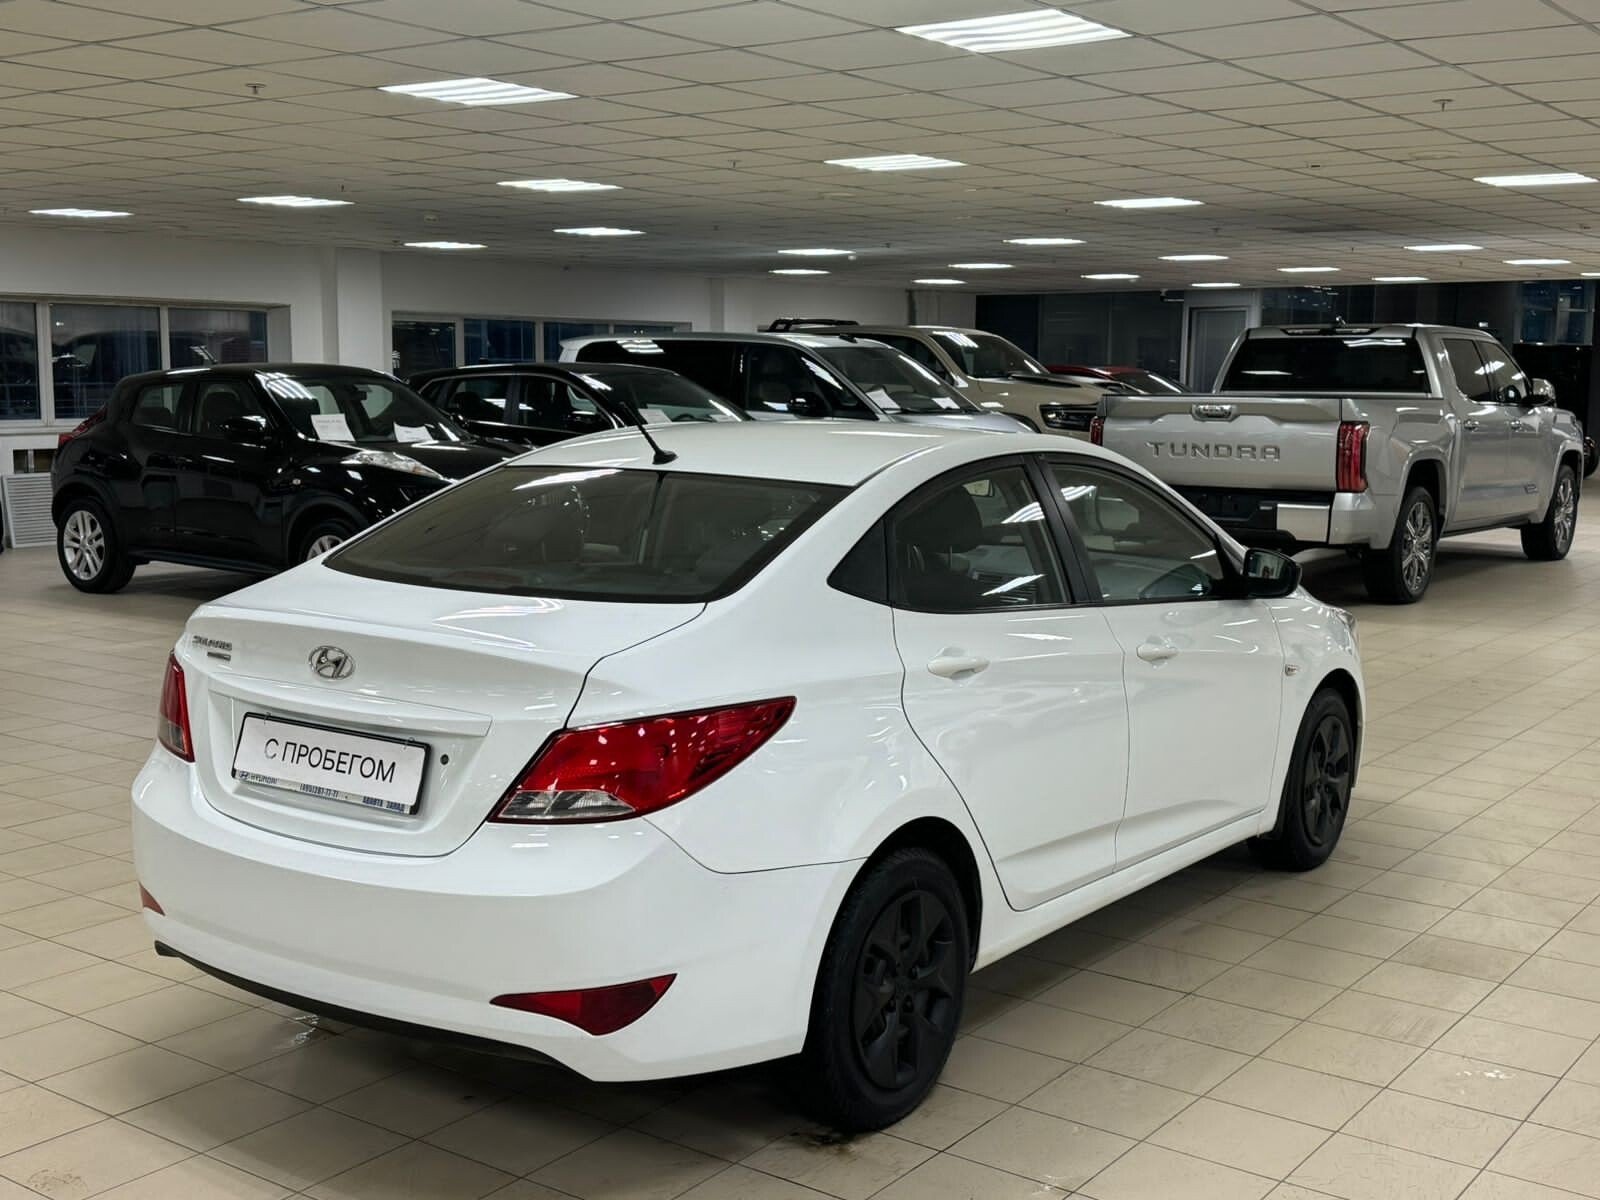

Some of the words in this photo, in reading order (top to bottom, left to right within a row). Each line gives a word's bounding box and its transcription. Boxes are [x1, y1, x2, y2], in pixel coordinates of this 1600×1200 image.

[1146, 441, 1281, 462] TUNDRA
[264, 738, 279, 760] С
[281, 741, 397, 784] ПРОБЕГОМ
